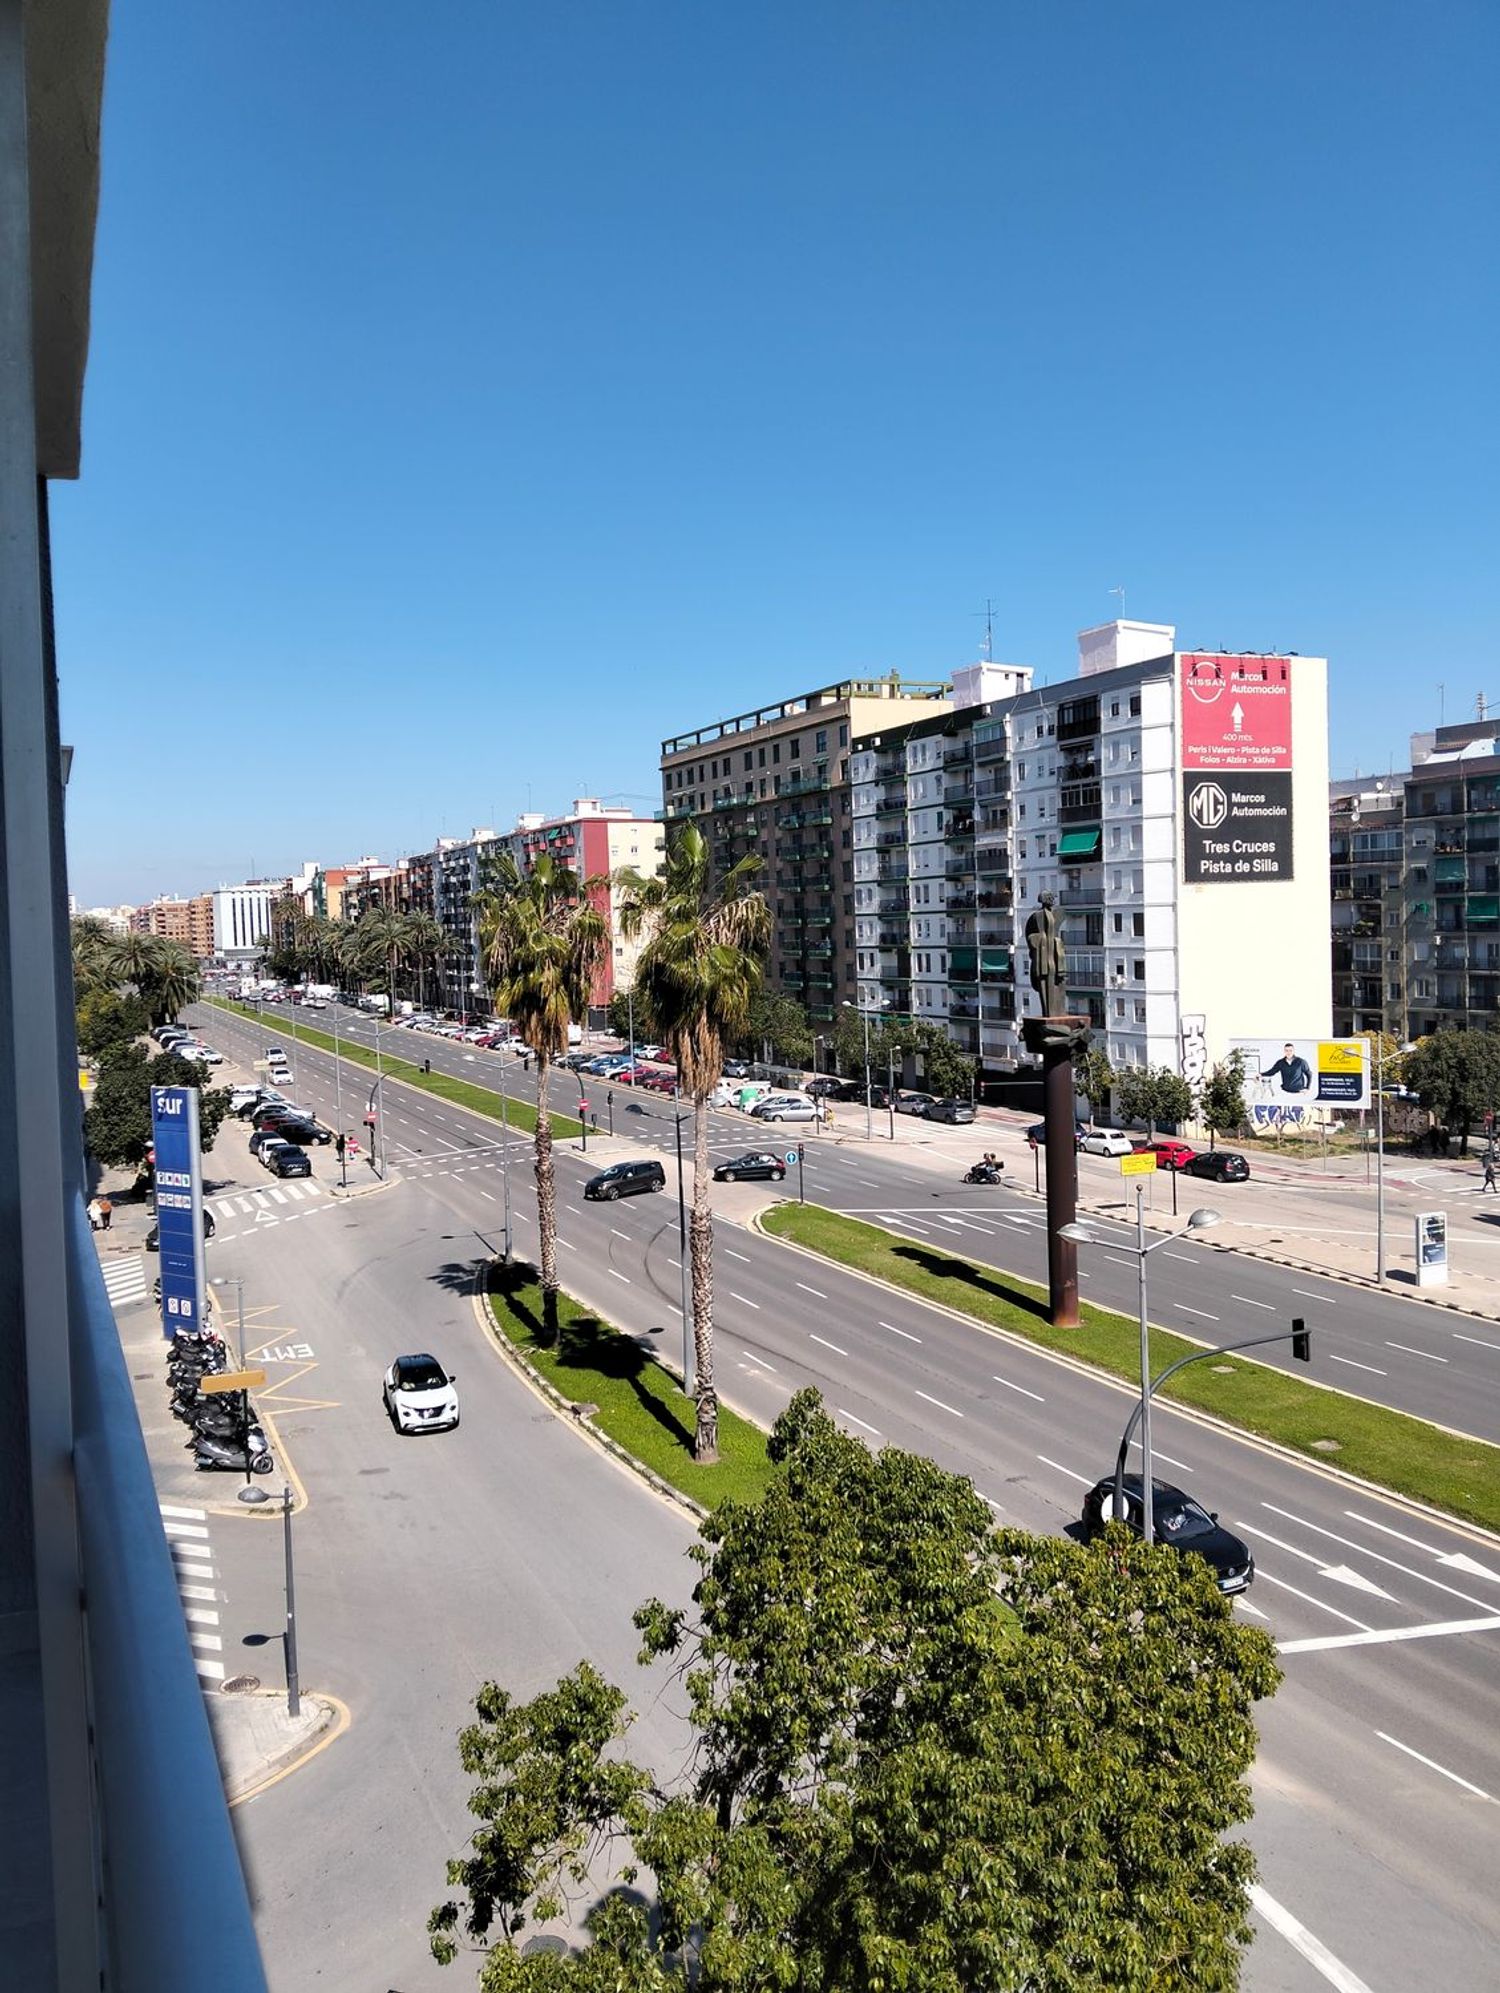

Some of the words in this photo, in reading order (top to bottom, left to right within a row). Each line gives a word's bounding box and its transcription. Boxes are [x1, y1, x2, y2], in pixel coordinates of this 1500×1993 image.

[1186, 677, 1226, 687] NISSAN
[1231, 684, 1286, 695] Automoción
[1223, 733, 1237, 741] 400
[1188, 746, 1207, 754] Peris
[1212, 746, 1235, 754] Valero
[1241, 746, 1260, 754] Pista
[1261, 746, 1270, 754] de
[1271, 746, 1287, 754] Silla
[1231, 792, 1266, 803] Marcos
[1193, 786, 1224, 825] MG
[1231, 805, 1287, 817] Automoción
[1202, 840, 1230, 853] Tres
[1232, 839, 1276, 853] Cruces
[1200, 859, 1233, 874] Pista
[1234, 859, 1250, 873] de
[1252, 858, 1279, 872] Silla
[260, 1343, 315, 1362] EMT
